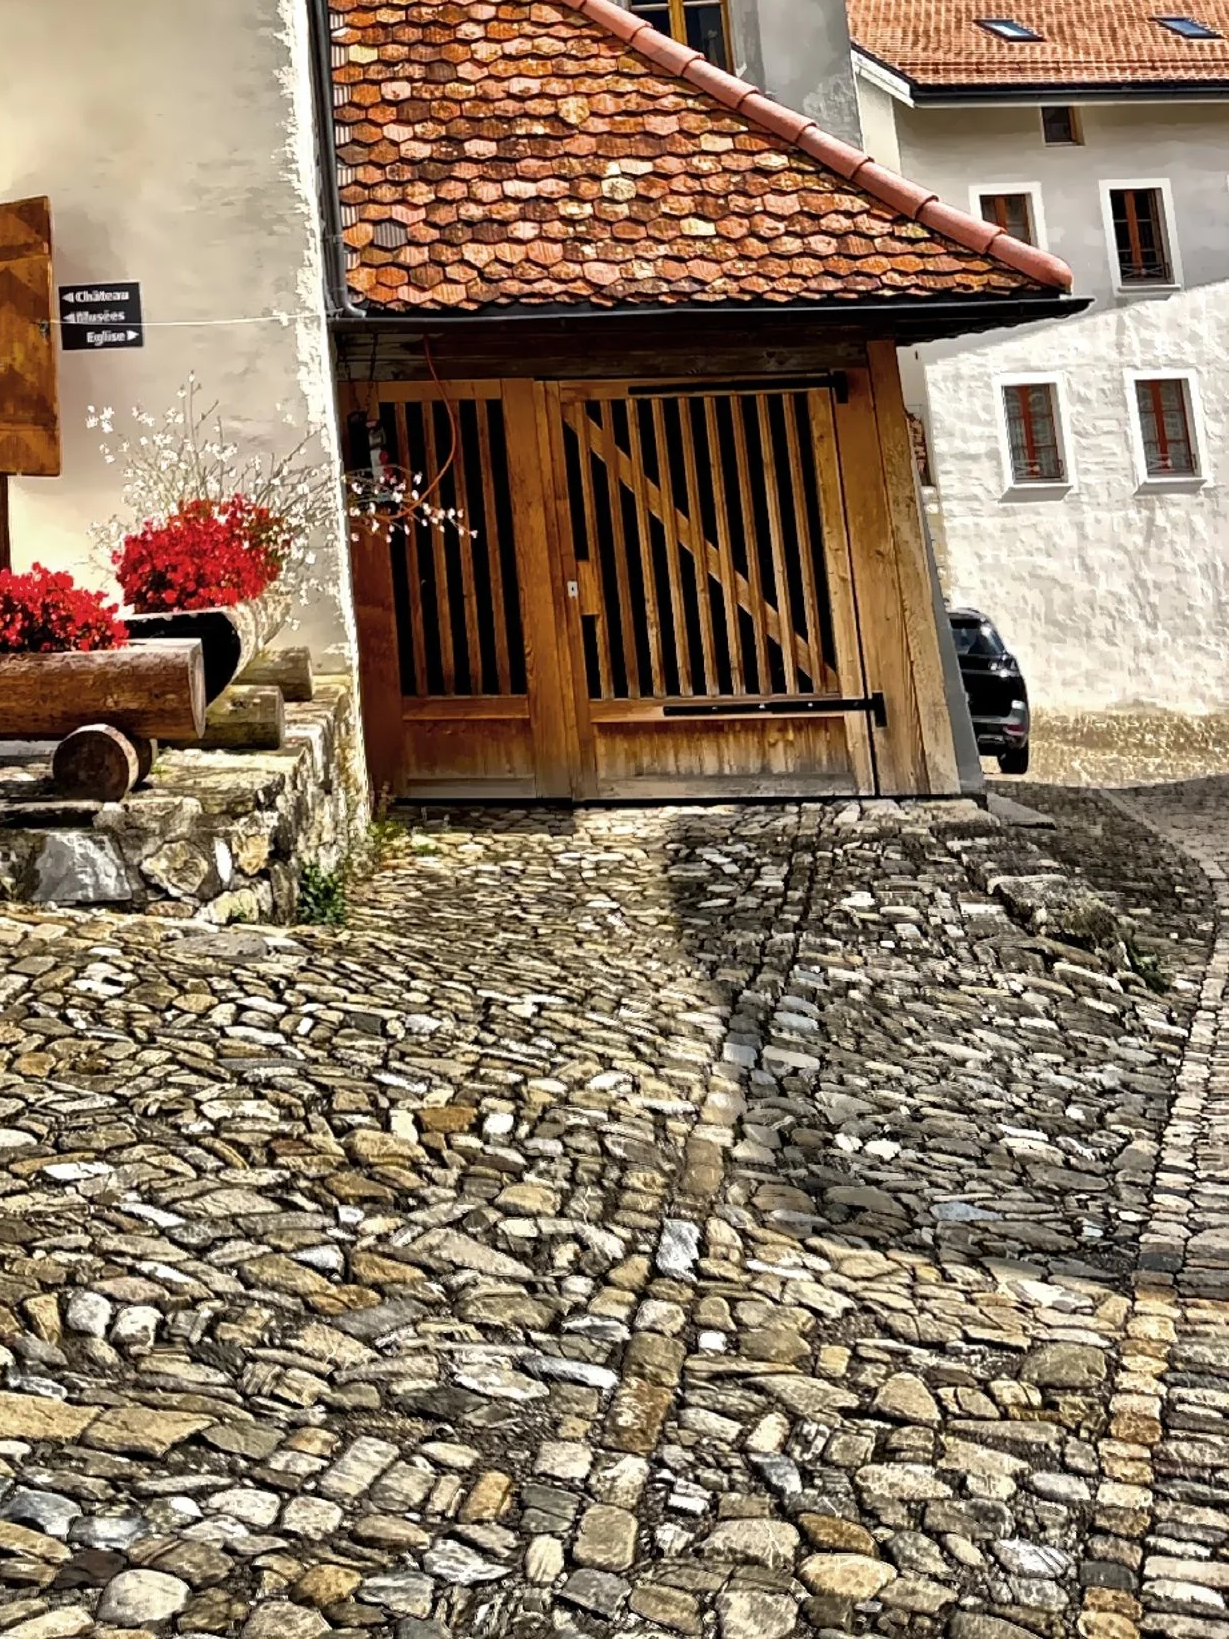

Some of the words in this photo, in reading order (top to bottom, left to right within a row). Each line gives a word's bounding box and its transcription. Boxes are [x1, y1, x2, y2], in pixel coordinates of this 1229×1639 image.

[75, 290, 130, 302] Château
[76, 310, 125, 324] Musées
[86, 330, 125, 347] Eglise
